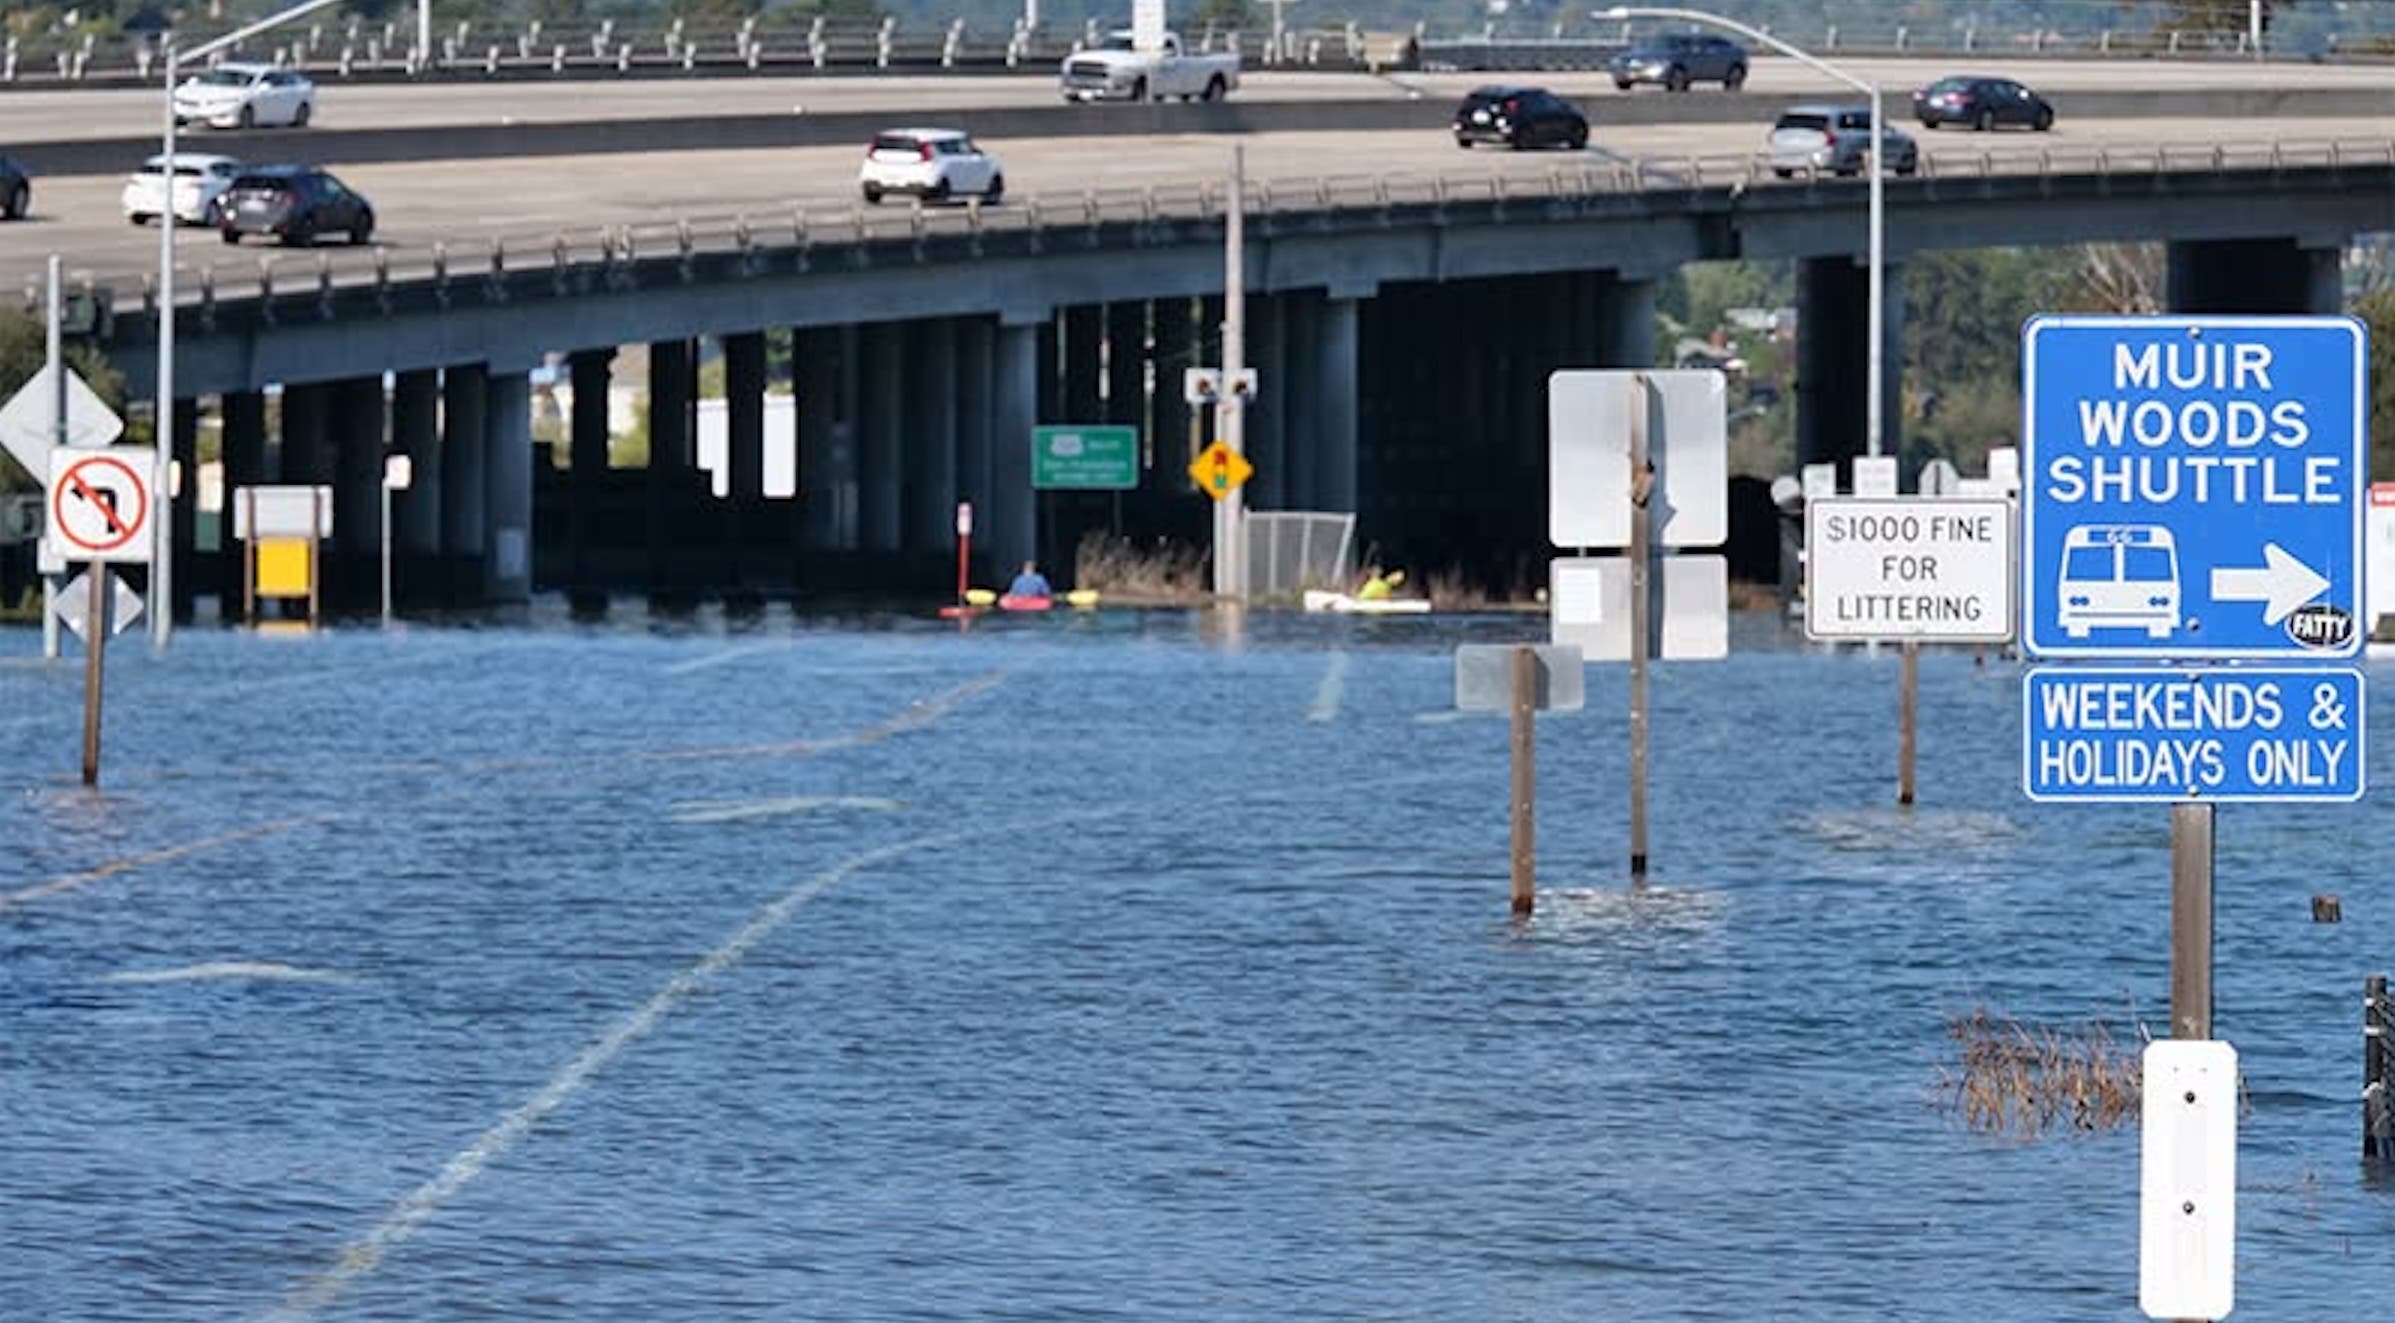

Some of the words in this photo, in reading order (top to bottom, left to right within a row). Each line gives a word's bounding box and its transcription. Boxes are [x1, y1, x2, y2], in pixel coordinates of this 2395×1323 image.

[2114, 343, 2272, 389] MUIR
[2079, 400, 2309, 448] WOODS
[2048, 456, 2341, 503] SHUTTLE
[1826, 515, 1920, 542] $1000
[1931, 516, 1992, 542] FINE
[1882, 555, 1938, 581] FOR
[1837, 596, 1982, 621] LITTERING
[2293, 613, 2350, 639] FATTY
[2041, 683, 2284, 730] WEEKENDS
[2308, 683, 2347, 730] &
[2040, 740, 2226, 786] HOLIDAYS
[2248, 740, 2348, 786] ONLY
